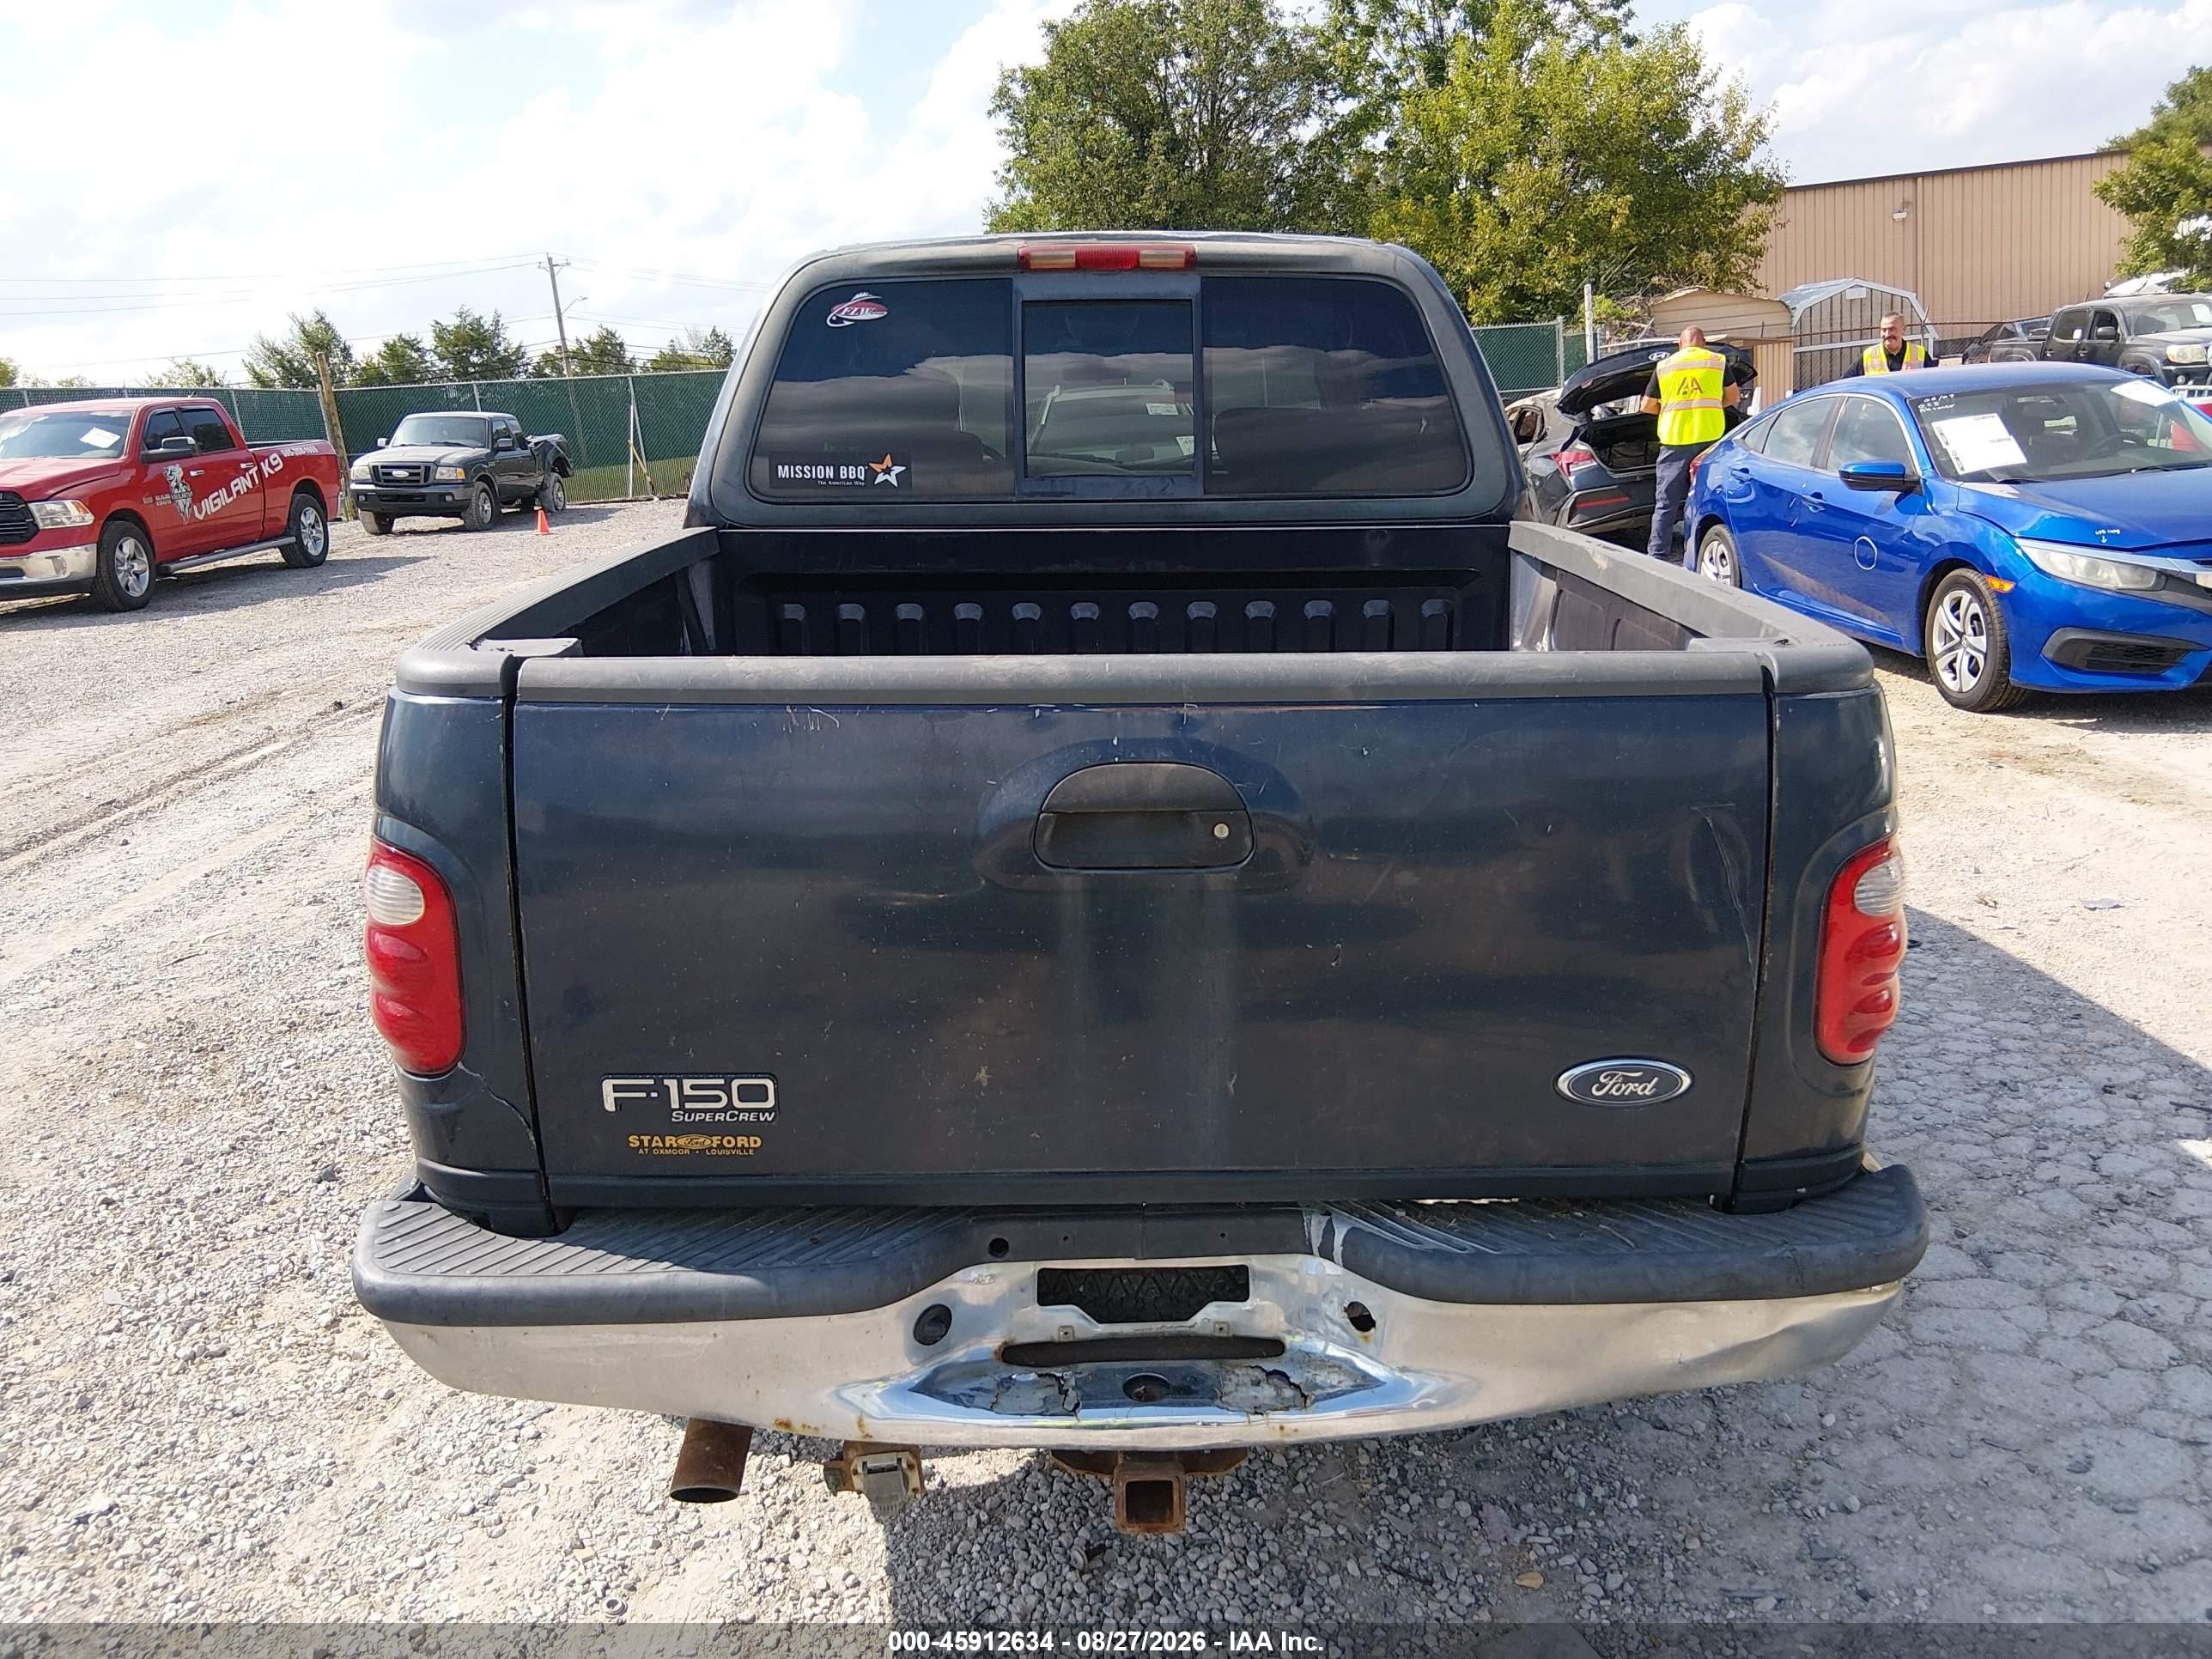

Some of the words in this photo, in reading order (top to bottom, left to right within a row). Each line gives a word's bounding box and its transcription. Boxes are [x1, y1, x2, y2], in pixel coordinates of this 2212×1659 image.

[192, 465, 258, 520] VIGILANT
[259, 453, 284, 479] K9
[777, 465, 834, 479] MISSION
[840, 465, 866, 481] BBQ
[602, 1079, 775, 1112] F-150
[1591, 1070, 1659, 1097] Ford
[628, 1134, 677, 1148] STAR
[712, 1135, 763, 1148] FORD
